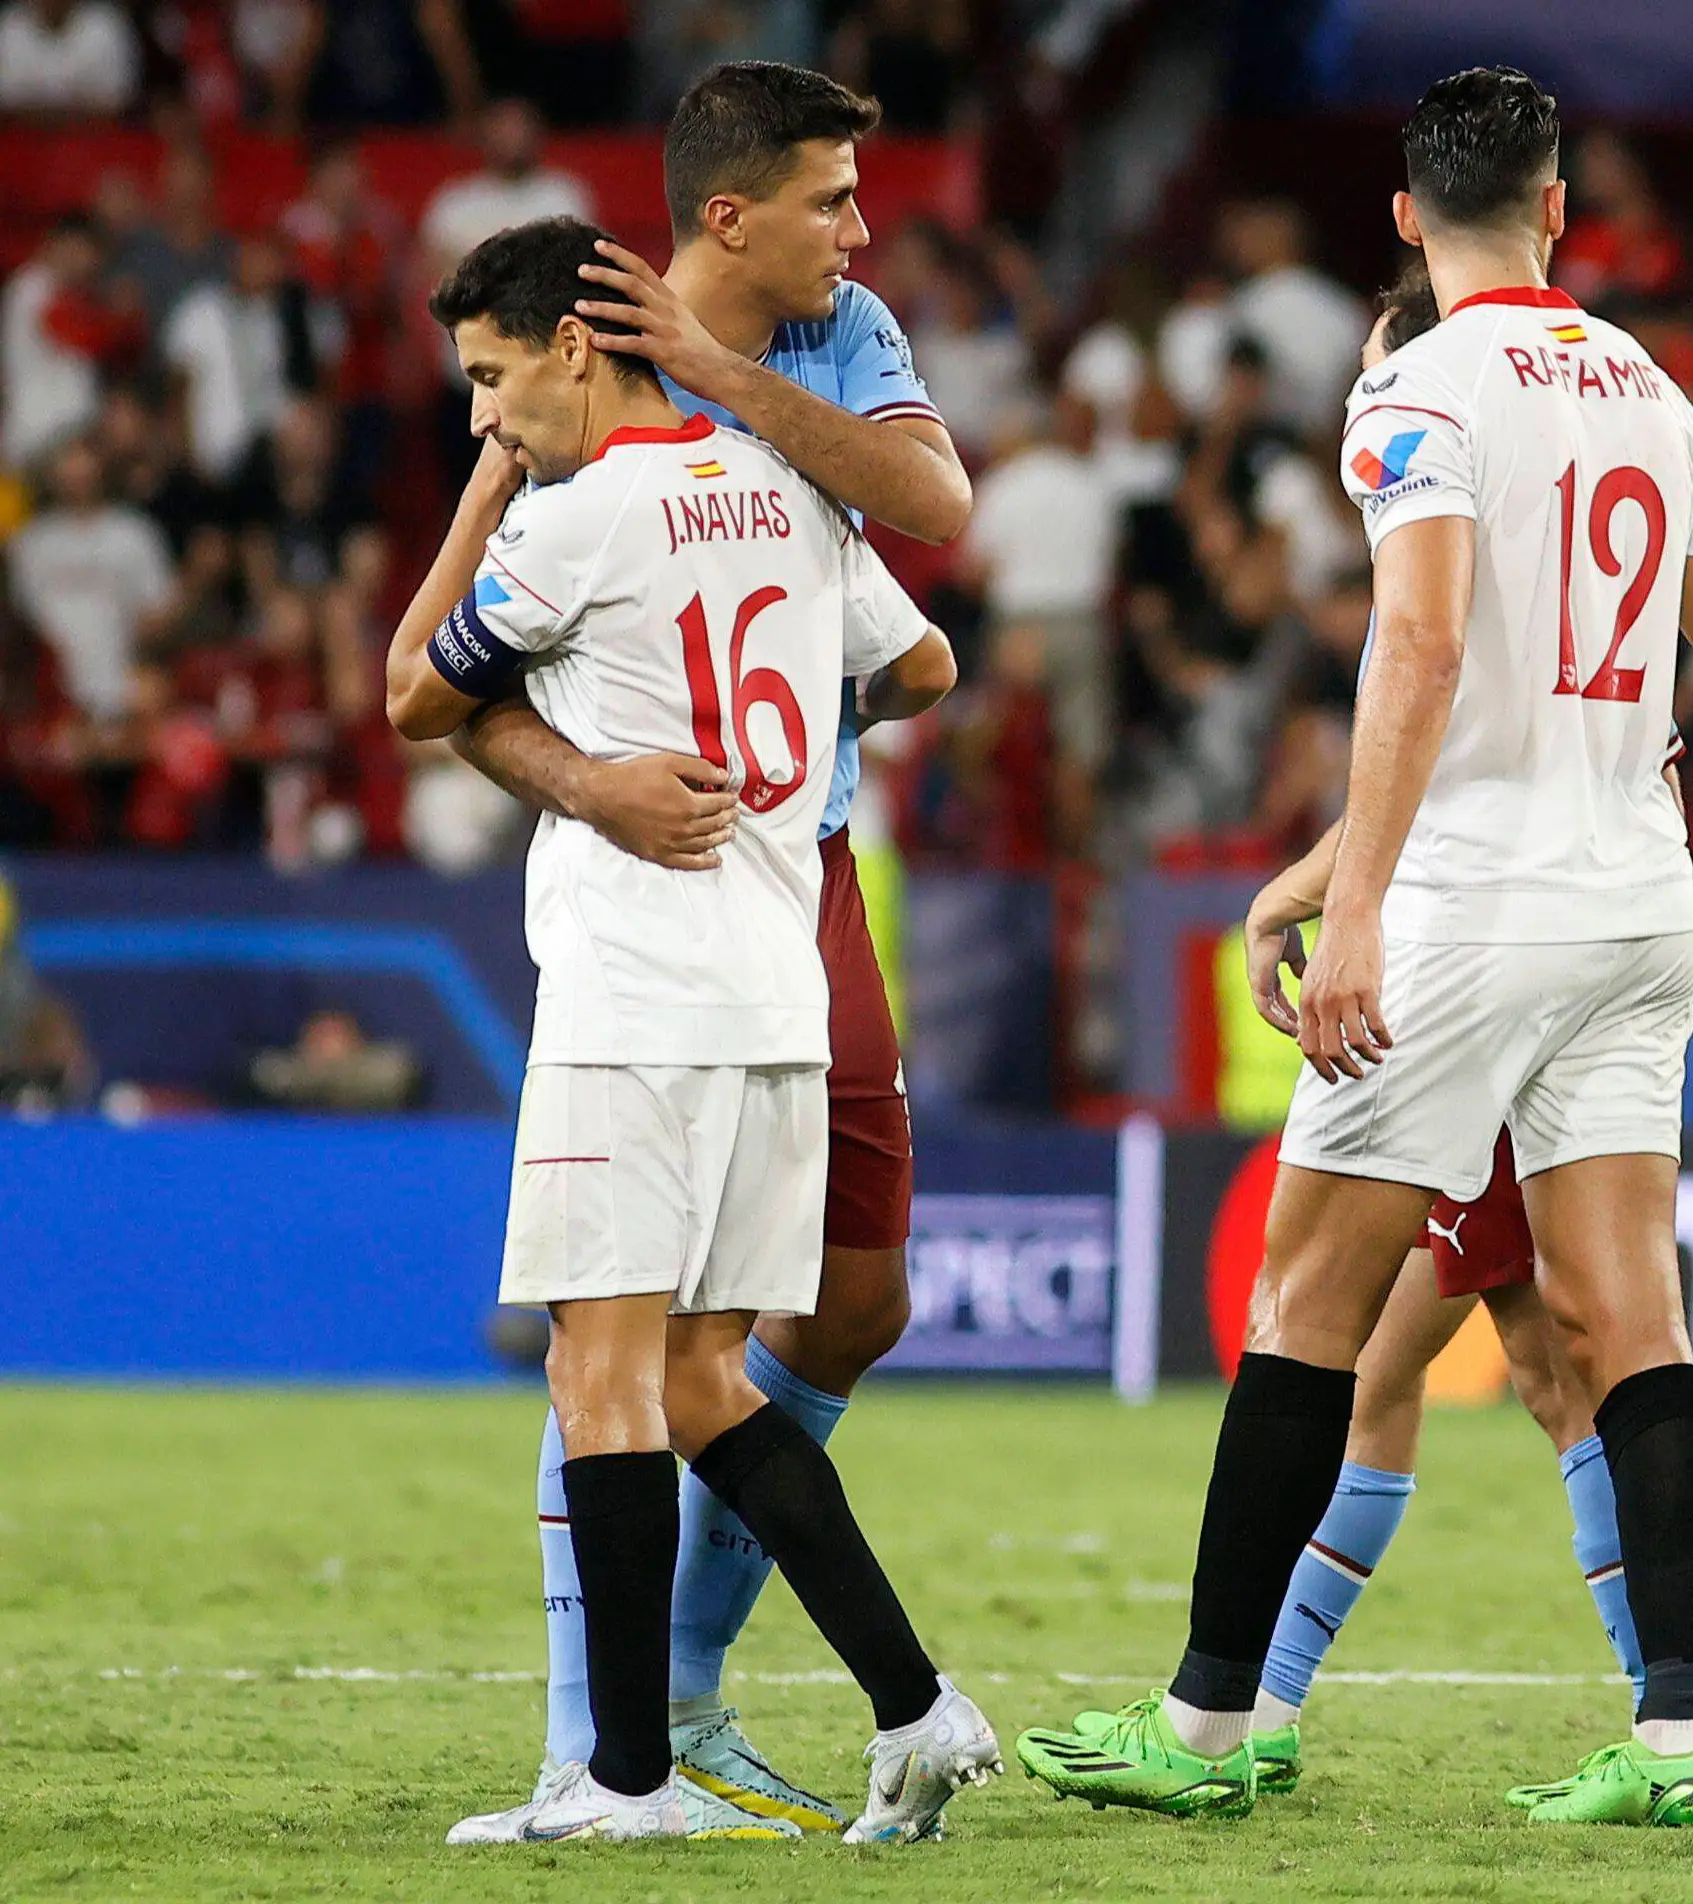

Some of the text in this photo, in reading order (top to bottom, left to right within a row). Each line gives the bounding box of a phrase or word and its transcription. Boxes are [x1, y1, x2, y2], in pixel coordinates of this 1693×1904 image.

[660, 490, 792, 556] J.NAVAS
[1553, 459, 1667, 703] 12
[438, 623, 472, 671] RESPECT
[455, 619, 491, 662] RACISM
[675, 585, 807, 813] 16
